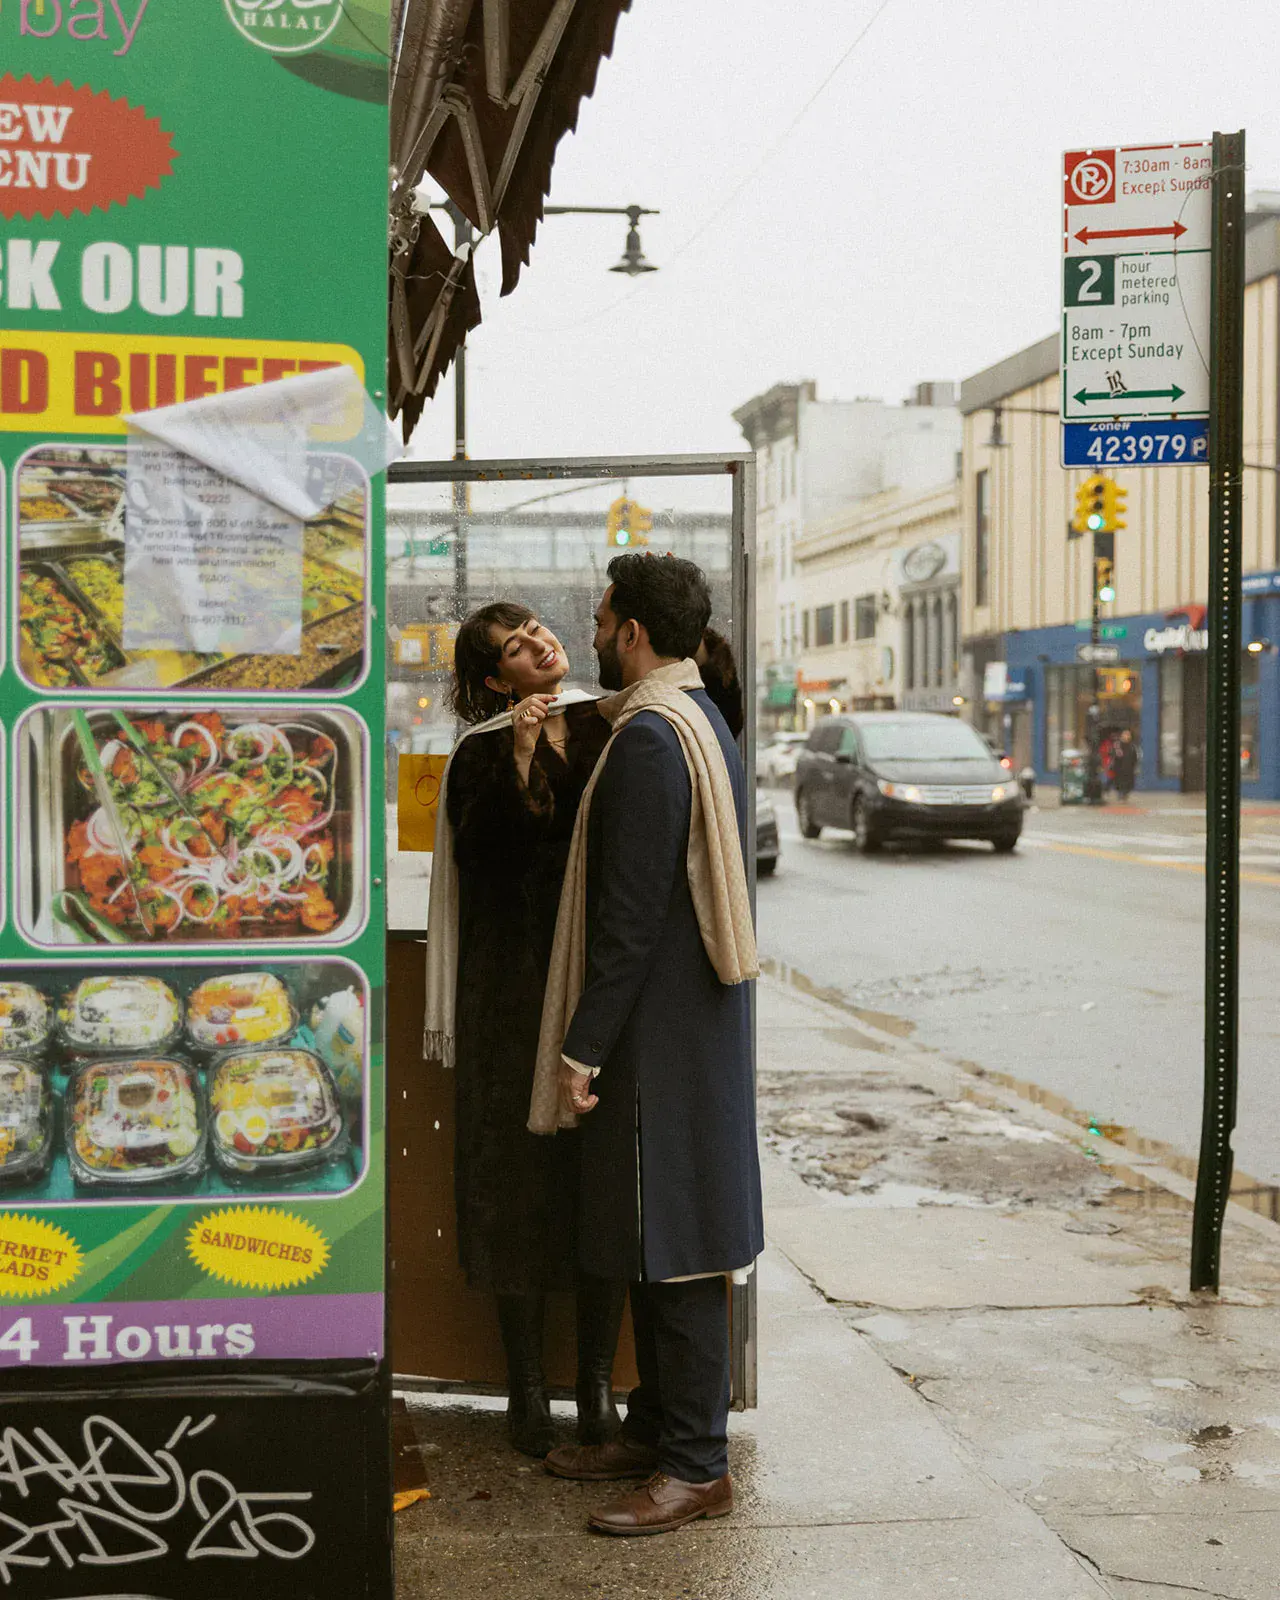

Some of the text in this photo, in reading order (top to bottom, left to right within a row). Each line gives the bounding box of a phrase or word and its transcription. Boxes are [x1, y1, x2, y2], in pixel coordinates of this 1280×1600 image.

[19, 0, 148, 56] bay
[243, 12, 326, 31] HALAL
[1123, 159, 1170, 174] 7:30am
[1183, 156, 1212, 170] 8am
[1122, 175, 1210, 196] Except Sunda
[1121, 261, 1152, 274] hour
[0, 239, 244, 318] K OUR
[1077, 259, 1103, 302] 2
[1121, 274, 1177, 290] metered
[1121, 290, 1170, 308] parking
[1072, 325, 1104, 341] 8am
[1120, 323, 1151, 342] 7pm
[1072, 342, 1184, 362] Except Sunday
[0, 348, 49, 415] D
[74, 350, 346, 416] BUFF
[1087, 434, 1187, 462] 423979
[200, 1227, 313, 1265] SANDWICHES
[0, 1260, 50, 1281] ADS
[0, 1315, 256, 1361] 4 Hours
